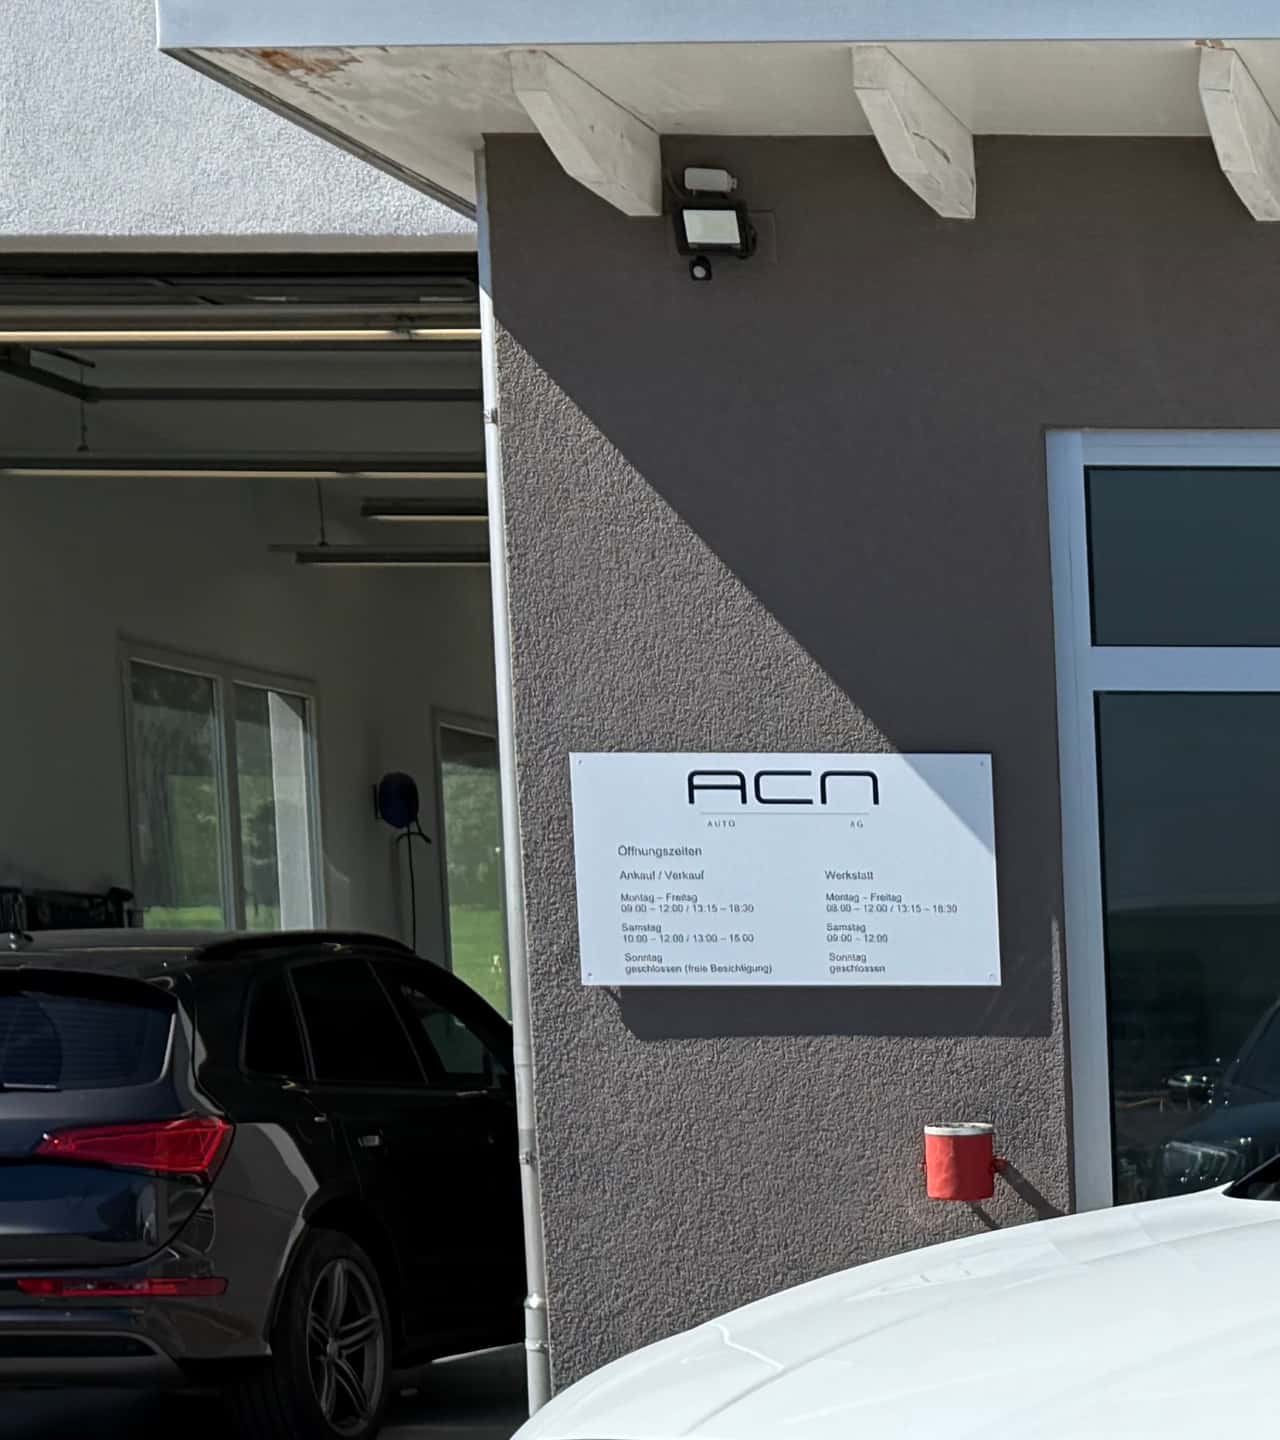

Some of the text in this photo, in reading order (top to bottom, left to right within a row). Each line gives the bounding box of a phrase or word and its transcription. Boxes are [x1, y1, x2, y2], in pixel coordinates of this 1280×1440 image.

[687, 769, 879, 805] ACN
[706, 819, 864, 829] AUTO AG
[617, 844, 702, 859] Öffnungszeiten
[619, 870, 656, 881] Ankauf
[664, 870, 705, 881] Verkauf
[824, 870, 874, 881] Werkstatt
[620, 893, 655, 903] Montag
[665, 893, 698, 903] Freitag
[826, 893, 860, 903] Montag
[870, 893, 902, 903] Freitag
[622, 923, 662, 933] Samstag
[826, 923, 866, 933] Samstag
[624, 953, 663, 963] Sonntag
[828, 953, 867, 963] Sonntag
[625, 963, 773, 976] geschlossen (freie Besichtigung)
[829, 964, 886, 975] geschlossen
